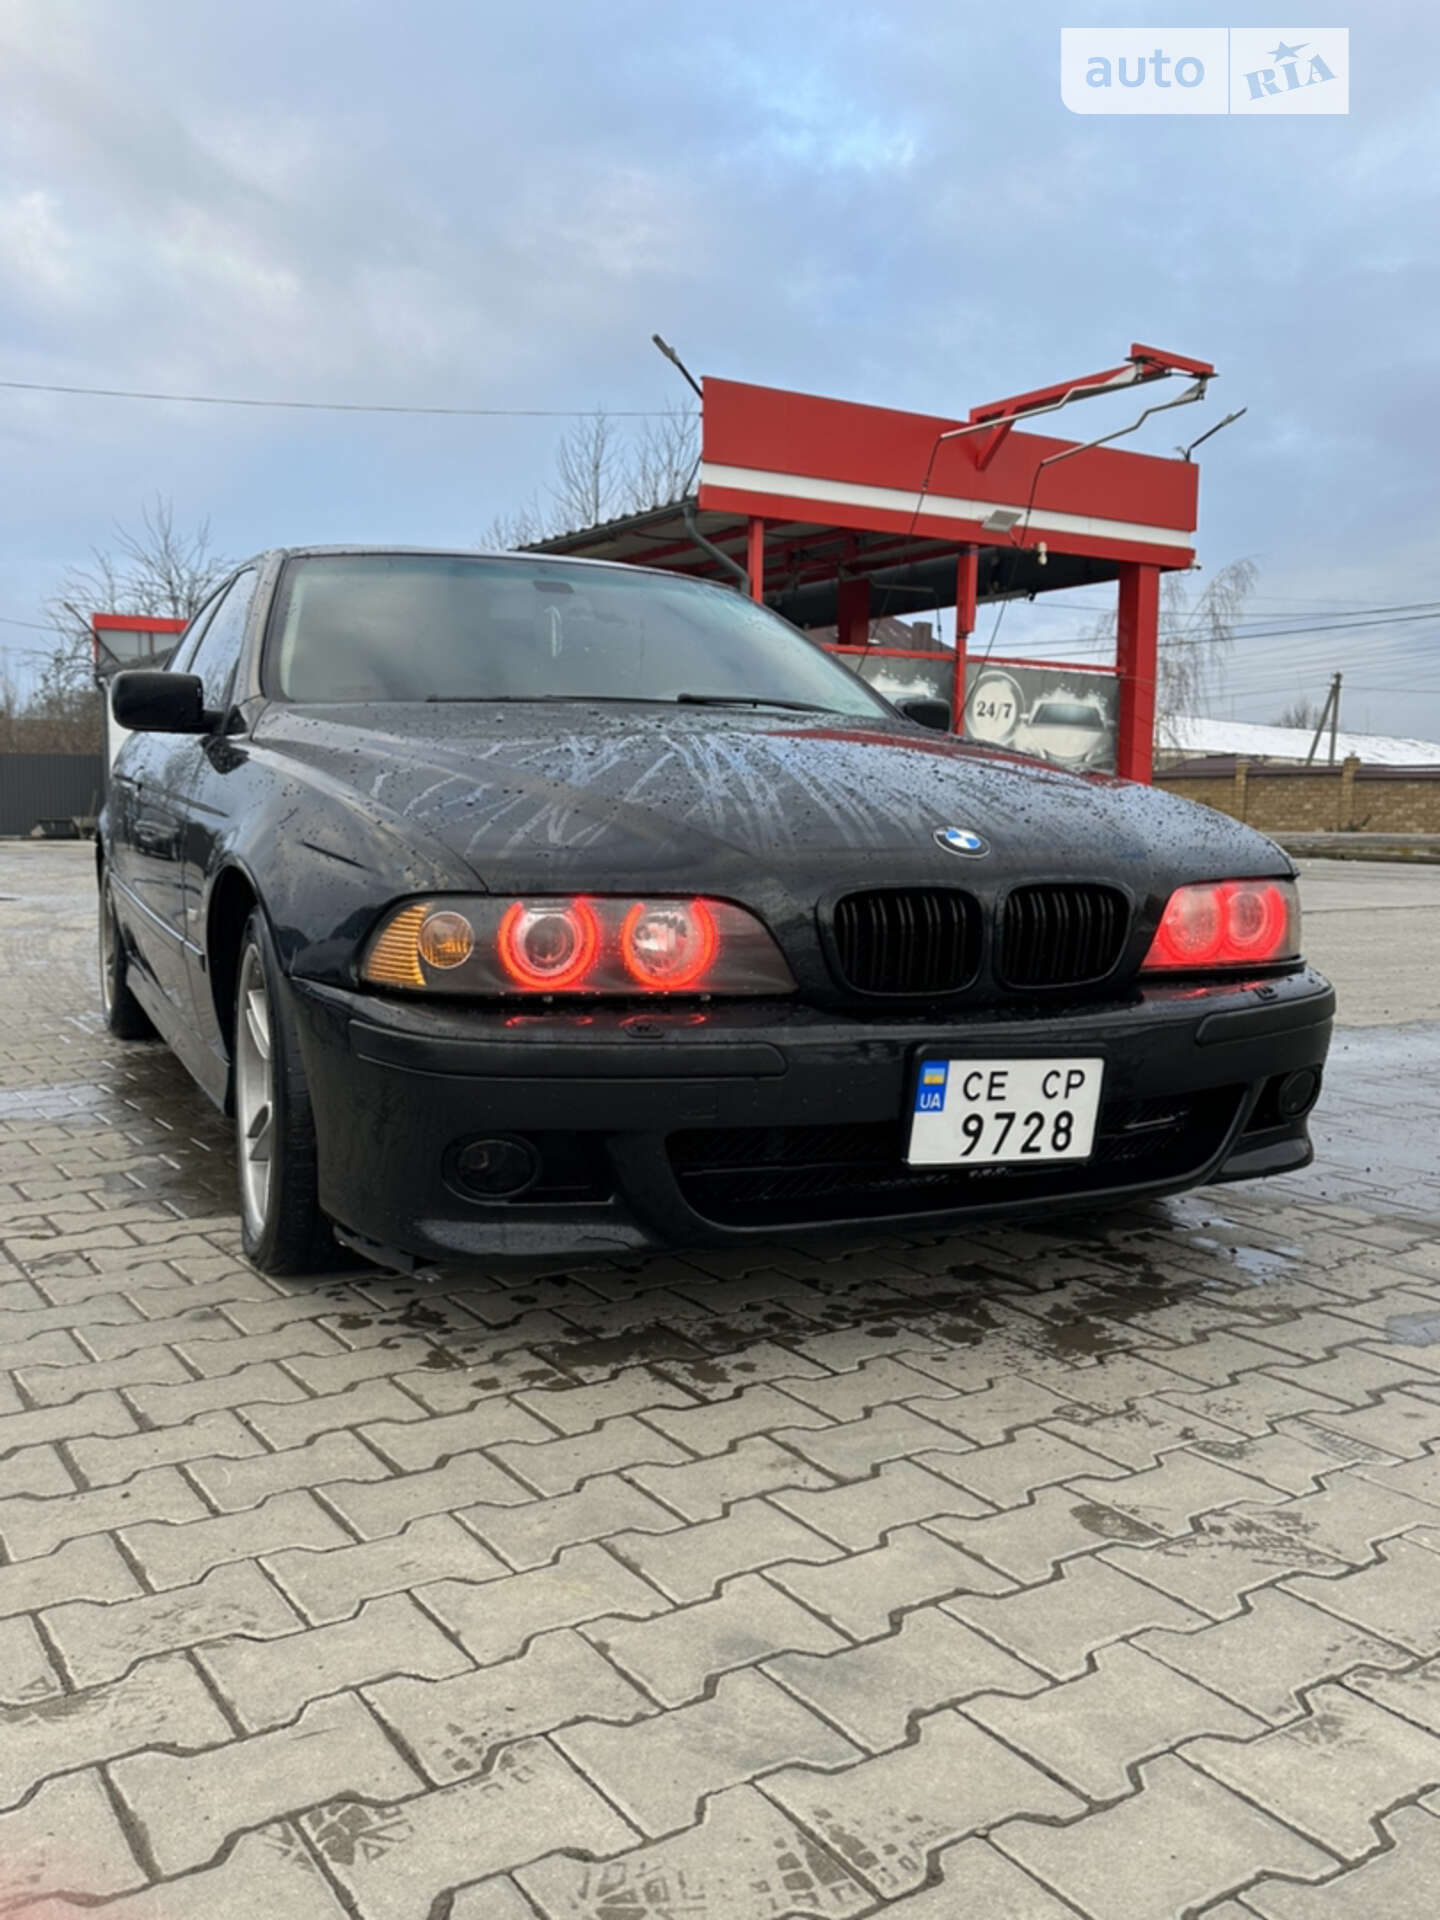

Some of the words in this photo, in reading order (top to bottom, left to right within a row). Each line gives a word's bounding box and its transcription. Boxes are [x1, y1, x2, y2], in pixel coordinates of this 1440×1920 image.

[976, 701, 1013, 719] 24/7
[962, 1071, 1009, 1101] CE
[1041, 1069, 1086, 1099] CP
[919, 1093, 941, 1109] UA
[960, 1110, 1074, 1156] 9728
